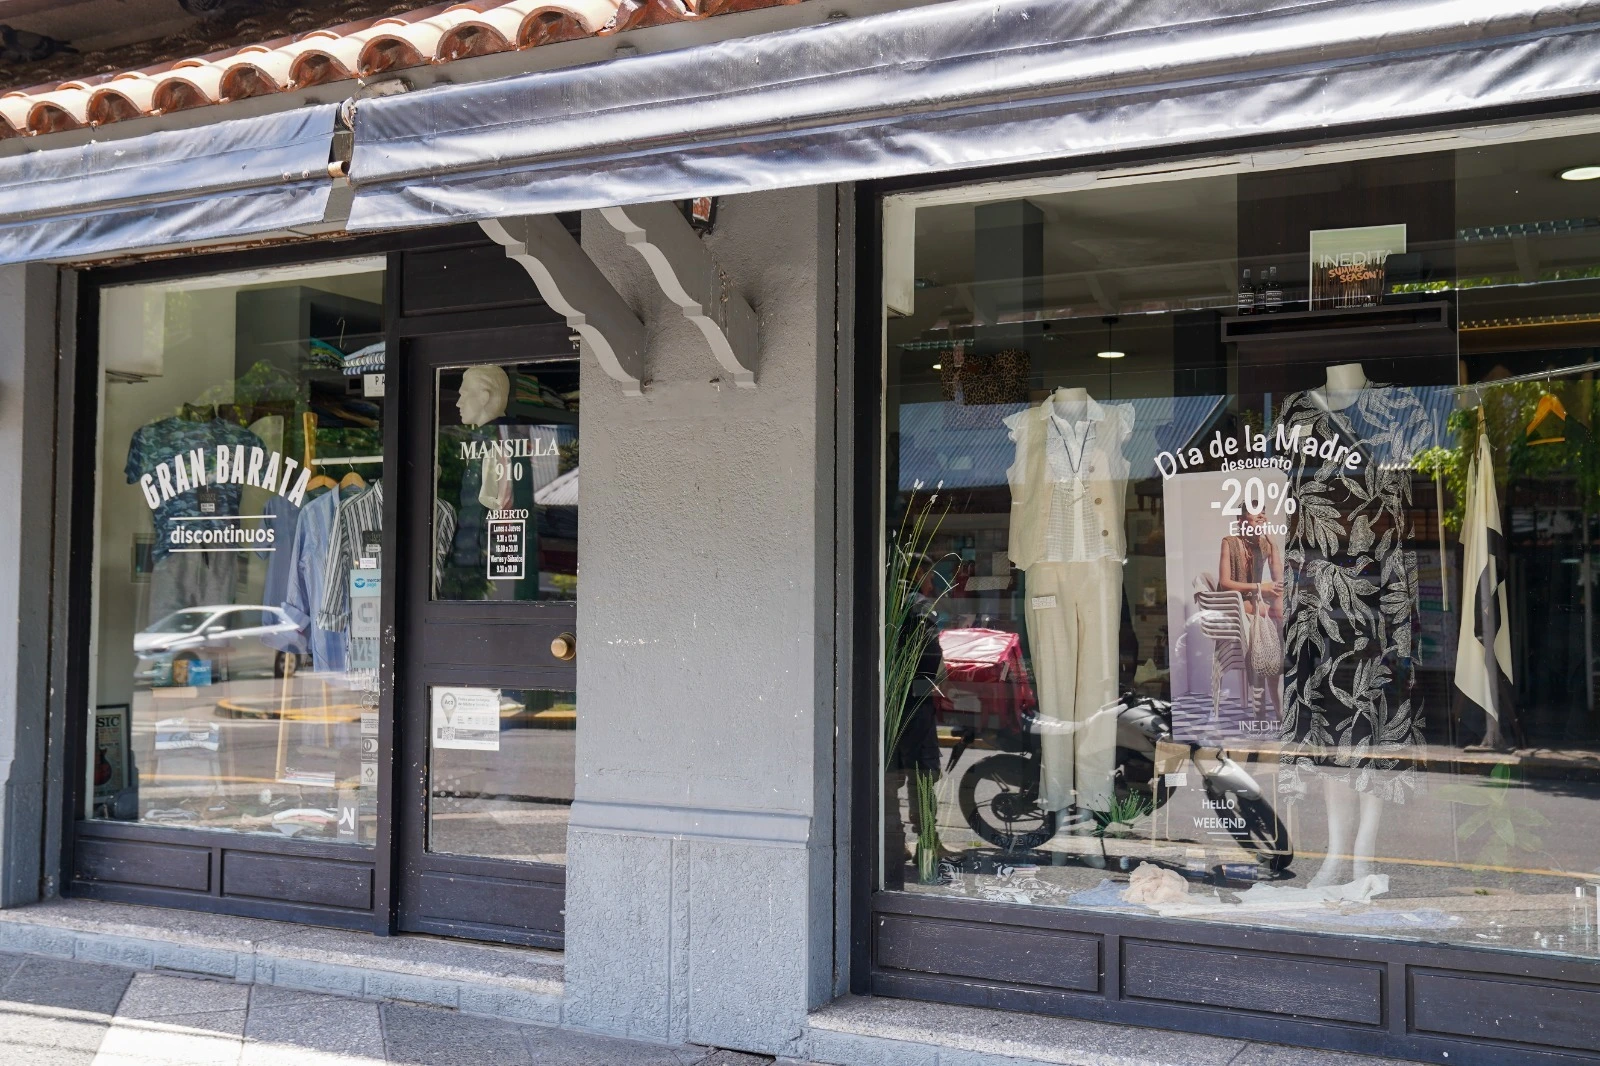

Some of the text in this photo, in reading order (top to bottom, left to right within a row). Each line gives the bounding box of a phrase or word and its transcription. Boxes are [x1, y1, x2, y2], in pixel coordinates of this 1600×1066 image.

[1328, 264, 1367, 278] SUMMER
[460, 437, 560, 460] MANSILLA
[1153, 423, 1363, 482] Día de la Madre
[495, 462, 523, 482] 910
[1220, 457, 1293, 474] descuento
[140, 444, 312, 510] GRAN BARATA
[1210, 476, 1297, 517] -20%
[485, 508, 529, 520] ABIERTO
[170, 523, 275, 544] discontinuos
[508, 524, 521, 532] Jueves
[1228, 520, 1289, 537] Efectivo
[1238, 720, 1283, 731] INEDIT
[1201, 799, 1235, 810] HELLO
[1193, 817, 1247, 829] WEEKEND
